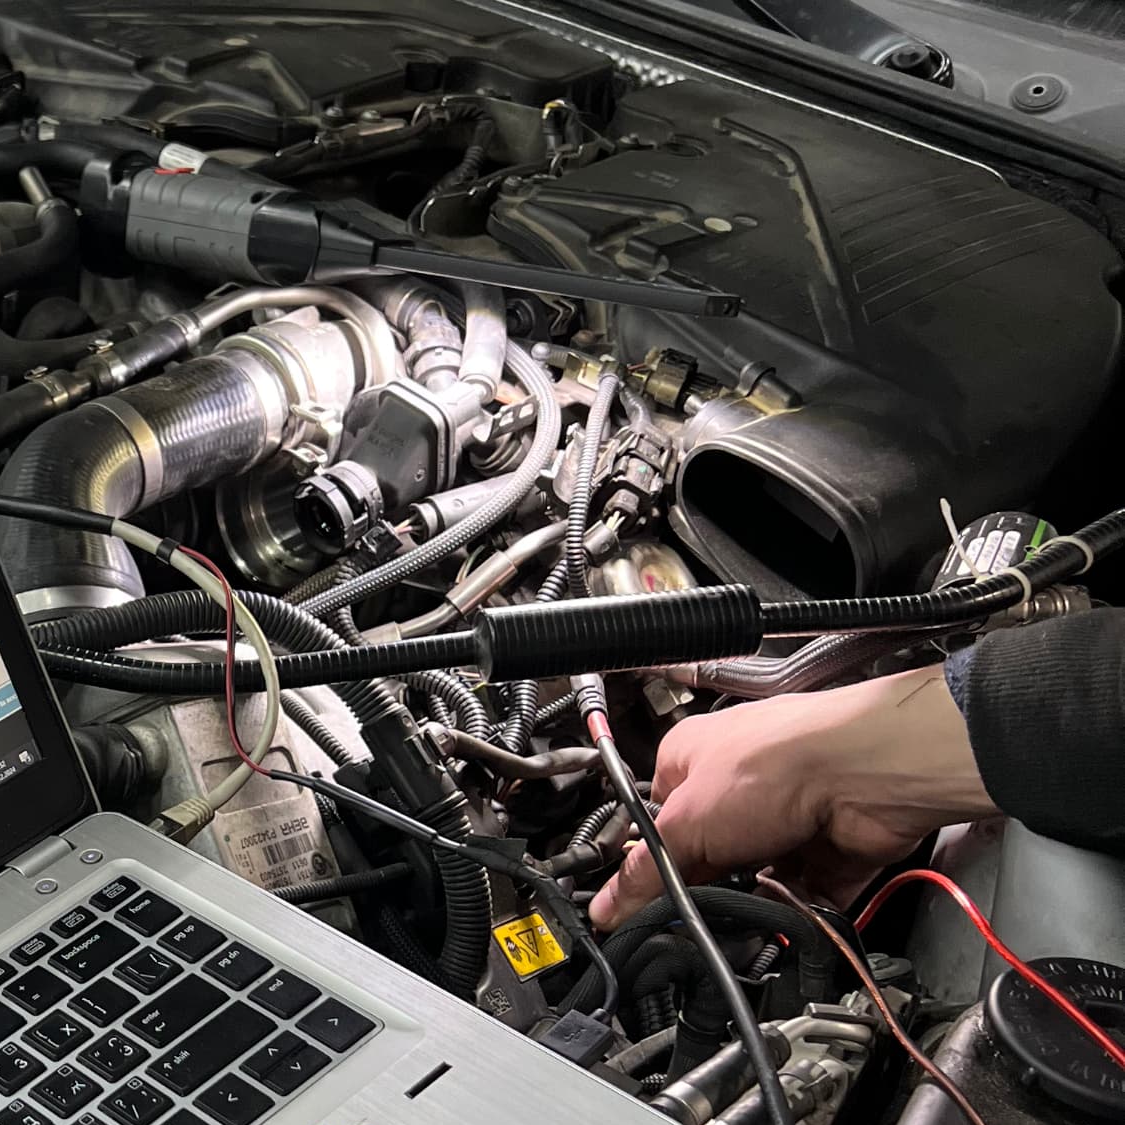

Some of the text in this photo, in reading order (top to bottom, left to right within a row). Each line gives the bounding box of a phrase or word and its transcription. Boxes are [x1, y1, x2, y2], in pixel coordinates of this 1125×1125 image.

[60, 932, 103, 961] backspace
[265, 978, 284, 991] end
[139, 1008, 162, 1024] enter
[169, 1049, 191, 1064] shift
